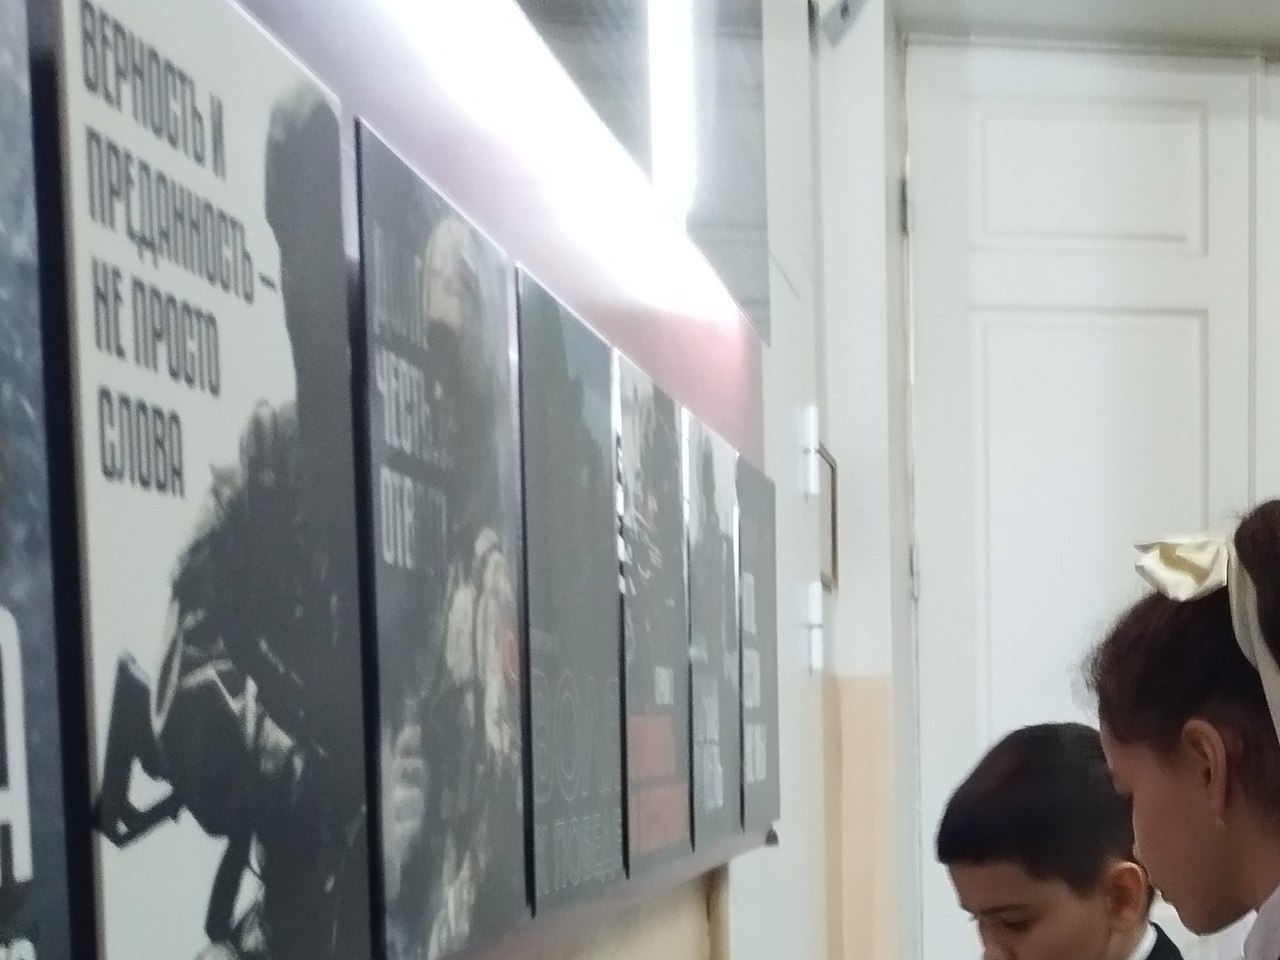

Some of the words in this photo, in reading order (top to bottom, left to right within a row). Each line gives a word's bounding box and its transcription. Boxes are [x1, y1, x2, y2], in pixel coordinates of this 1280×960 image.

[80, 0, 206, 168] ВЕРНОСТЬ
[209, 92, 227, 181] И
[84, 125, 254, 305] ПРЕДАННОСТЬ
[91, 255, 126, 363] НЕ
[130, 280, 221, 398] ПРОСТО
[97, 383, 185, 500] СЛОВА
